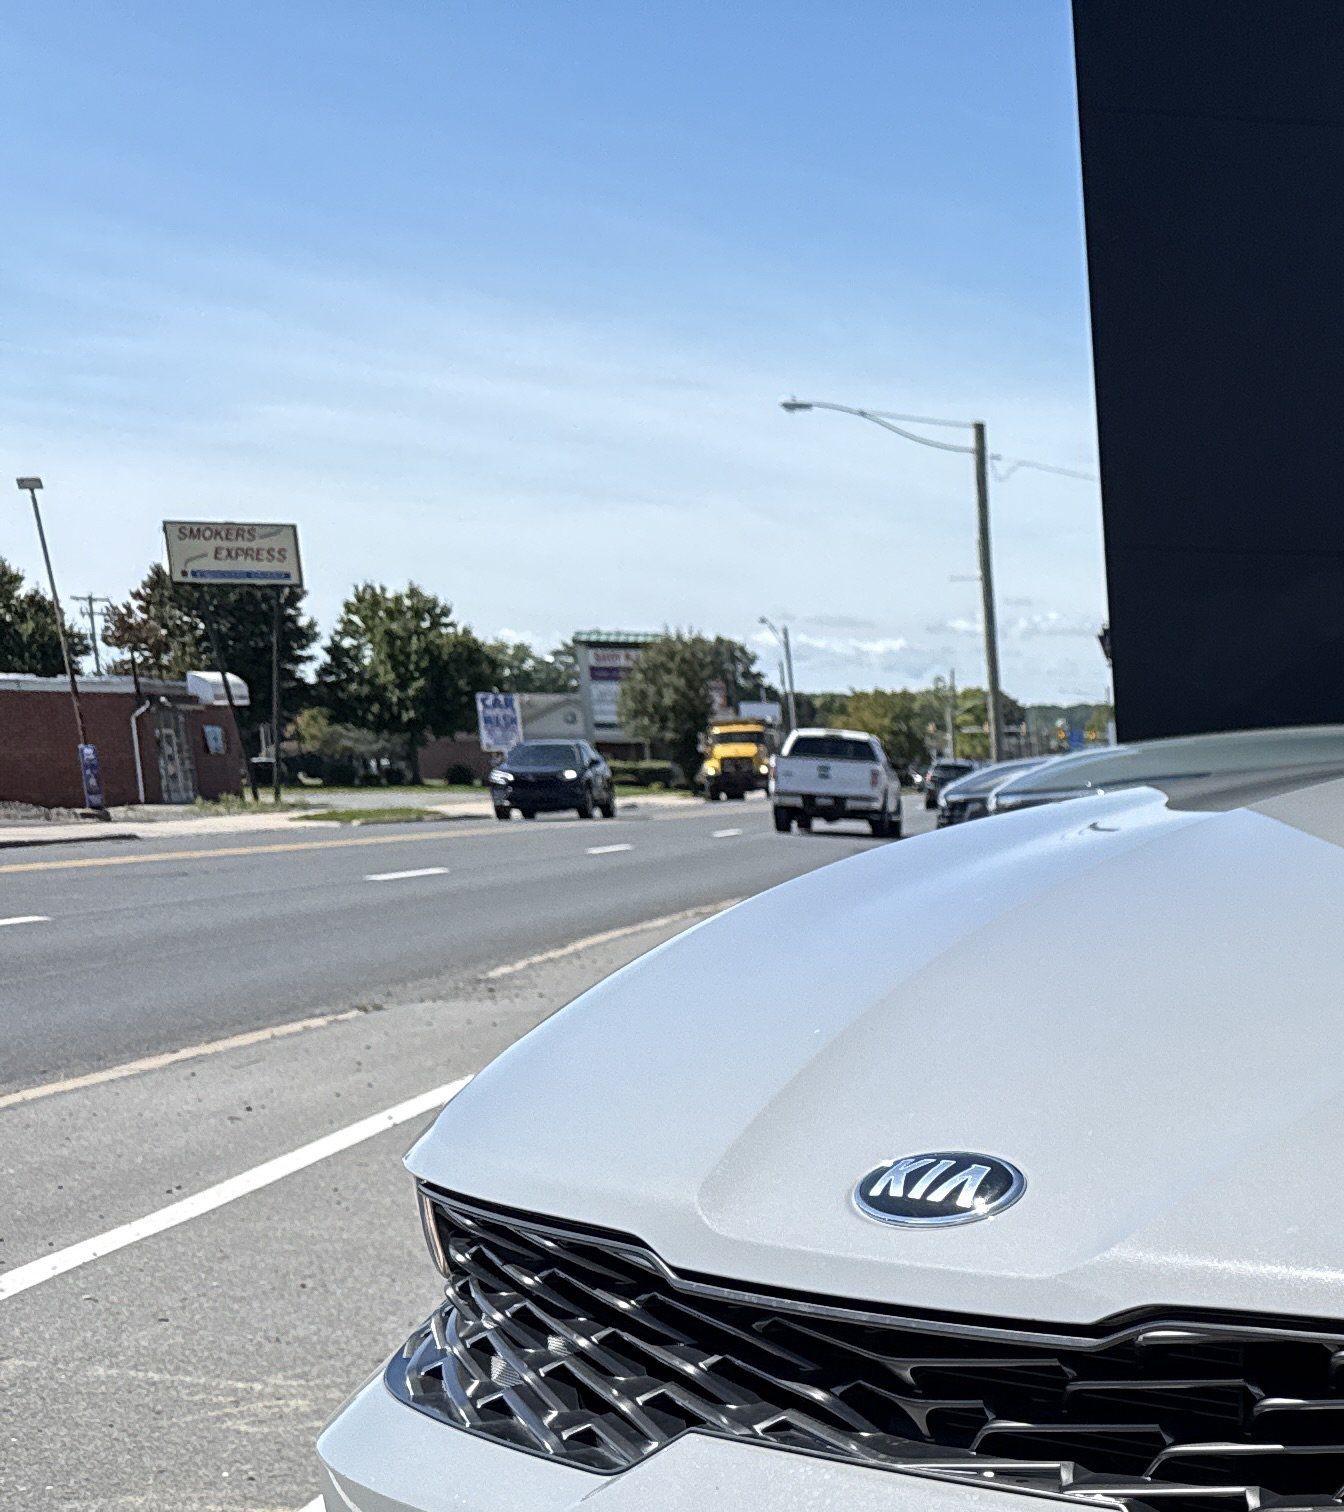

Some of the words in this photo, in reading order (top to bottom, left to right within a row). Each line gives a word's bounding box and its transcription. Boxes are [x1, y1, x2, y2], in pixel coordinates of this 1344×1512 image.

[177, 526, 257, 542] SMOKERS
[213, 546, 288, 563] EXPRESS
[868, 1158, 992, 1209] KIA
